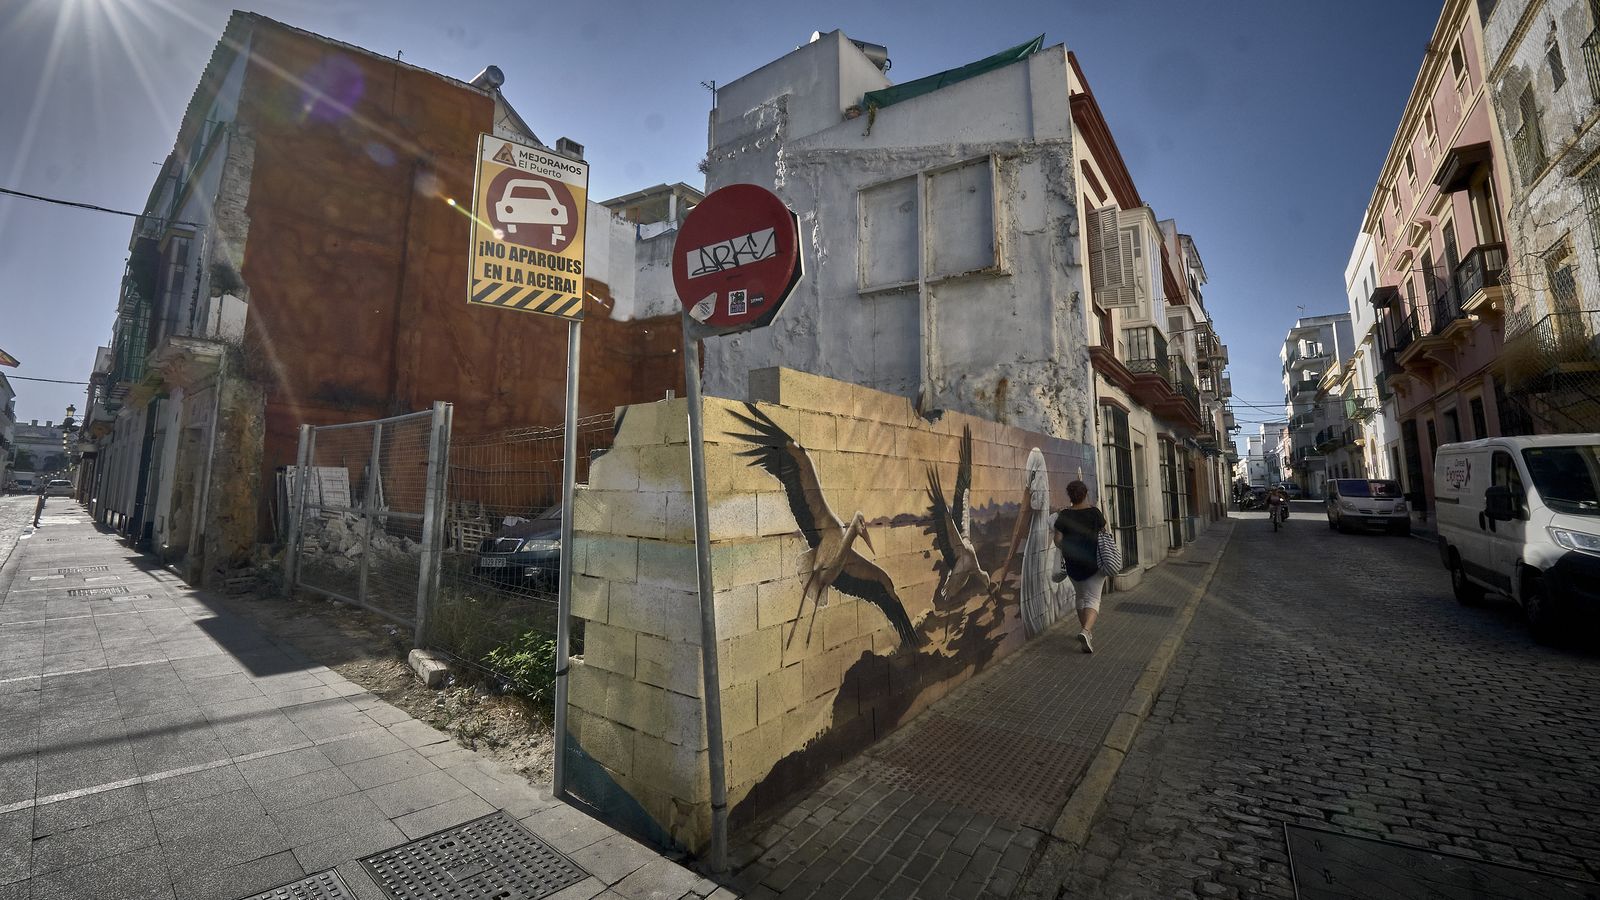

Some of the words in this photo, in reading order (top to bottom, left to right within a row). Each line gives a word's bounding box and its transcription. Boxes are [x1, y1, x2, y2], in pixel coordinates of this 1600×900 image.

[518, 160, 529, 169] El
[530, 164, 562, 179] Puerto
[519, 150, 582, 175] MEJORAMOS
[479, 240, 506, 259] ¡NO
[508, 246, 582, 275] APARQUES
[484, 262, 503, 280] EN
[506, 267, 524, 284] LA
[526, 271, 577, 294] ACERA!
